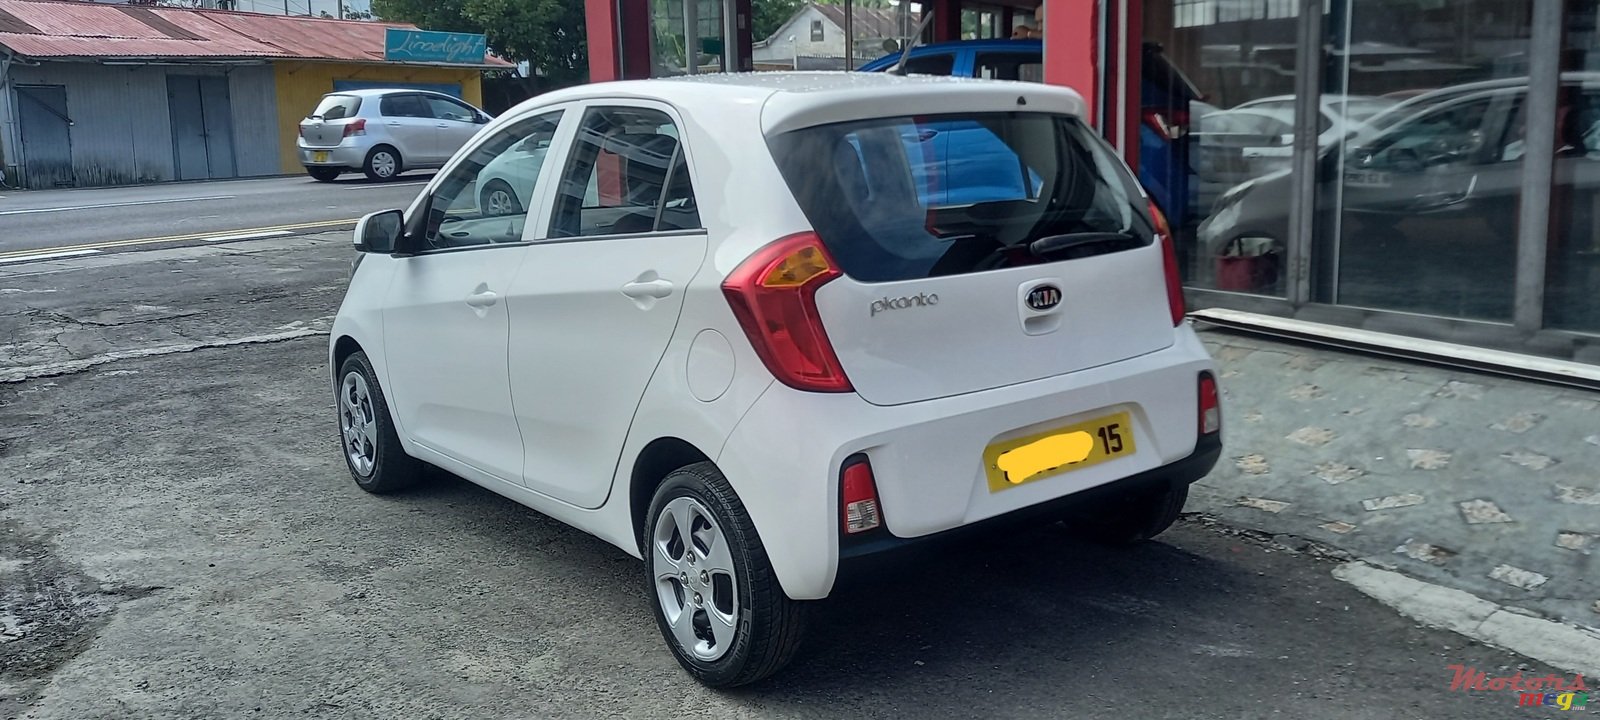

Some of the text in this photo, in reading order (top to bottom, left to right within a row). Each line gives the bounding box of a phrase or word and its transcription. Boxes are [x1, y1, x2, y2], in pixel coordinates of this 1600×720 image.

[389, 31, 484, 61] Limelight
[870, 292, 939, 317] picanto
[1031, 289, 1059, 307] KIA
[1098, 423, 1123, 455] 15
